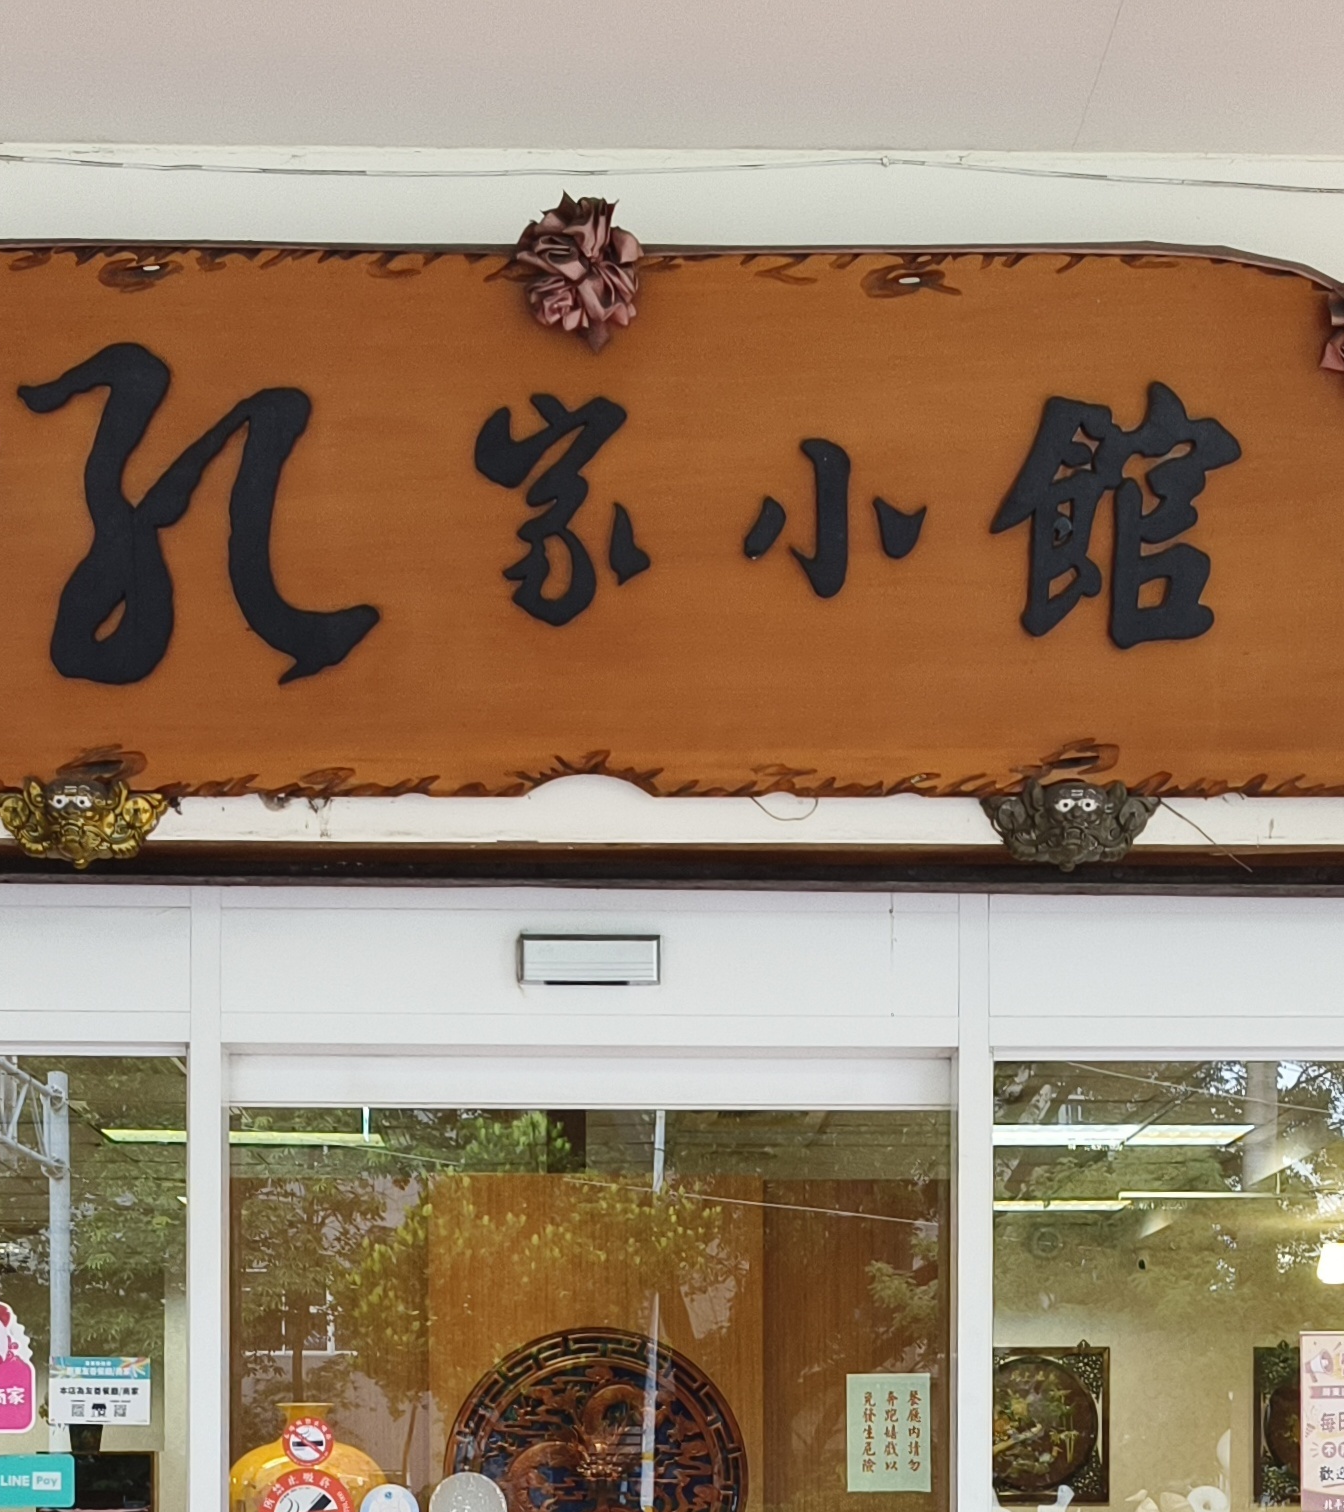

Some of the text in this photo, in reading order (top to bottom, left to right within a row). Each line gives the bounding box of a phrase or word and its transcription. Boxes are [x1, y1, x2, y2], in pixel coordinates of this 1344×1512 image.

[17, 342, 1243, 686] 孔家小館
[0, 1474, 58, 1488] LINE Pay
